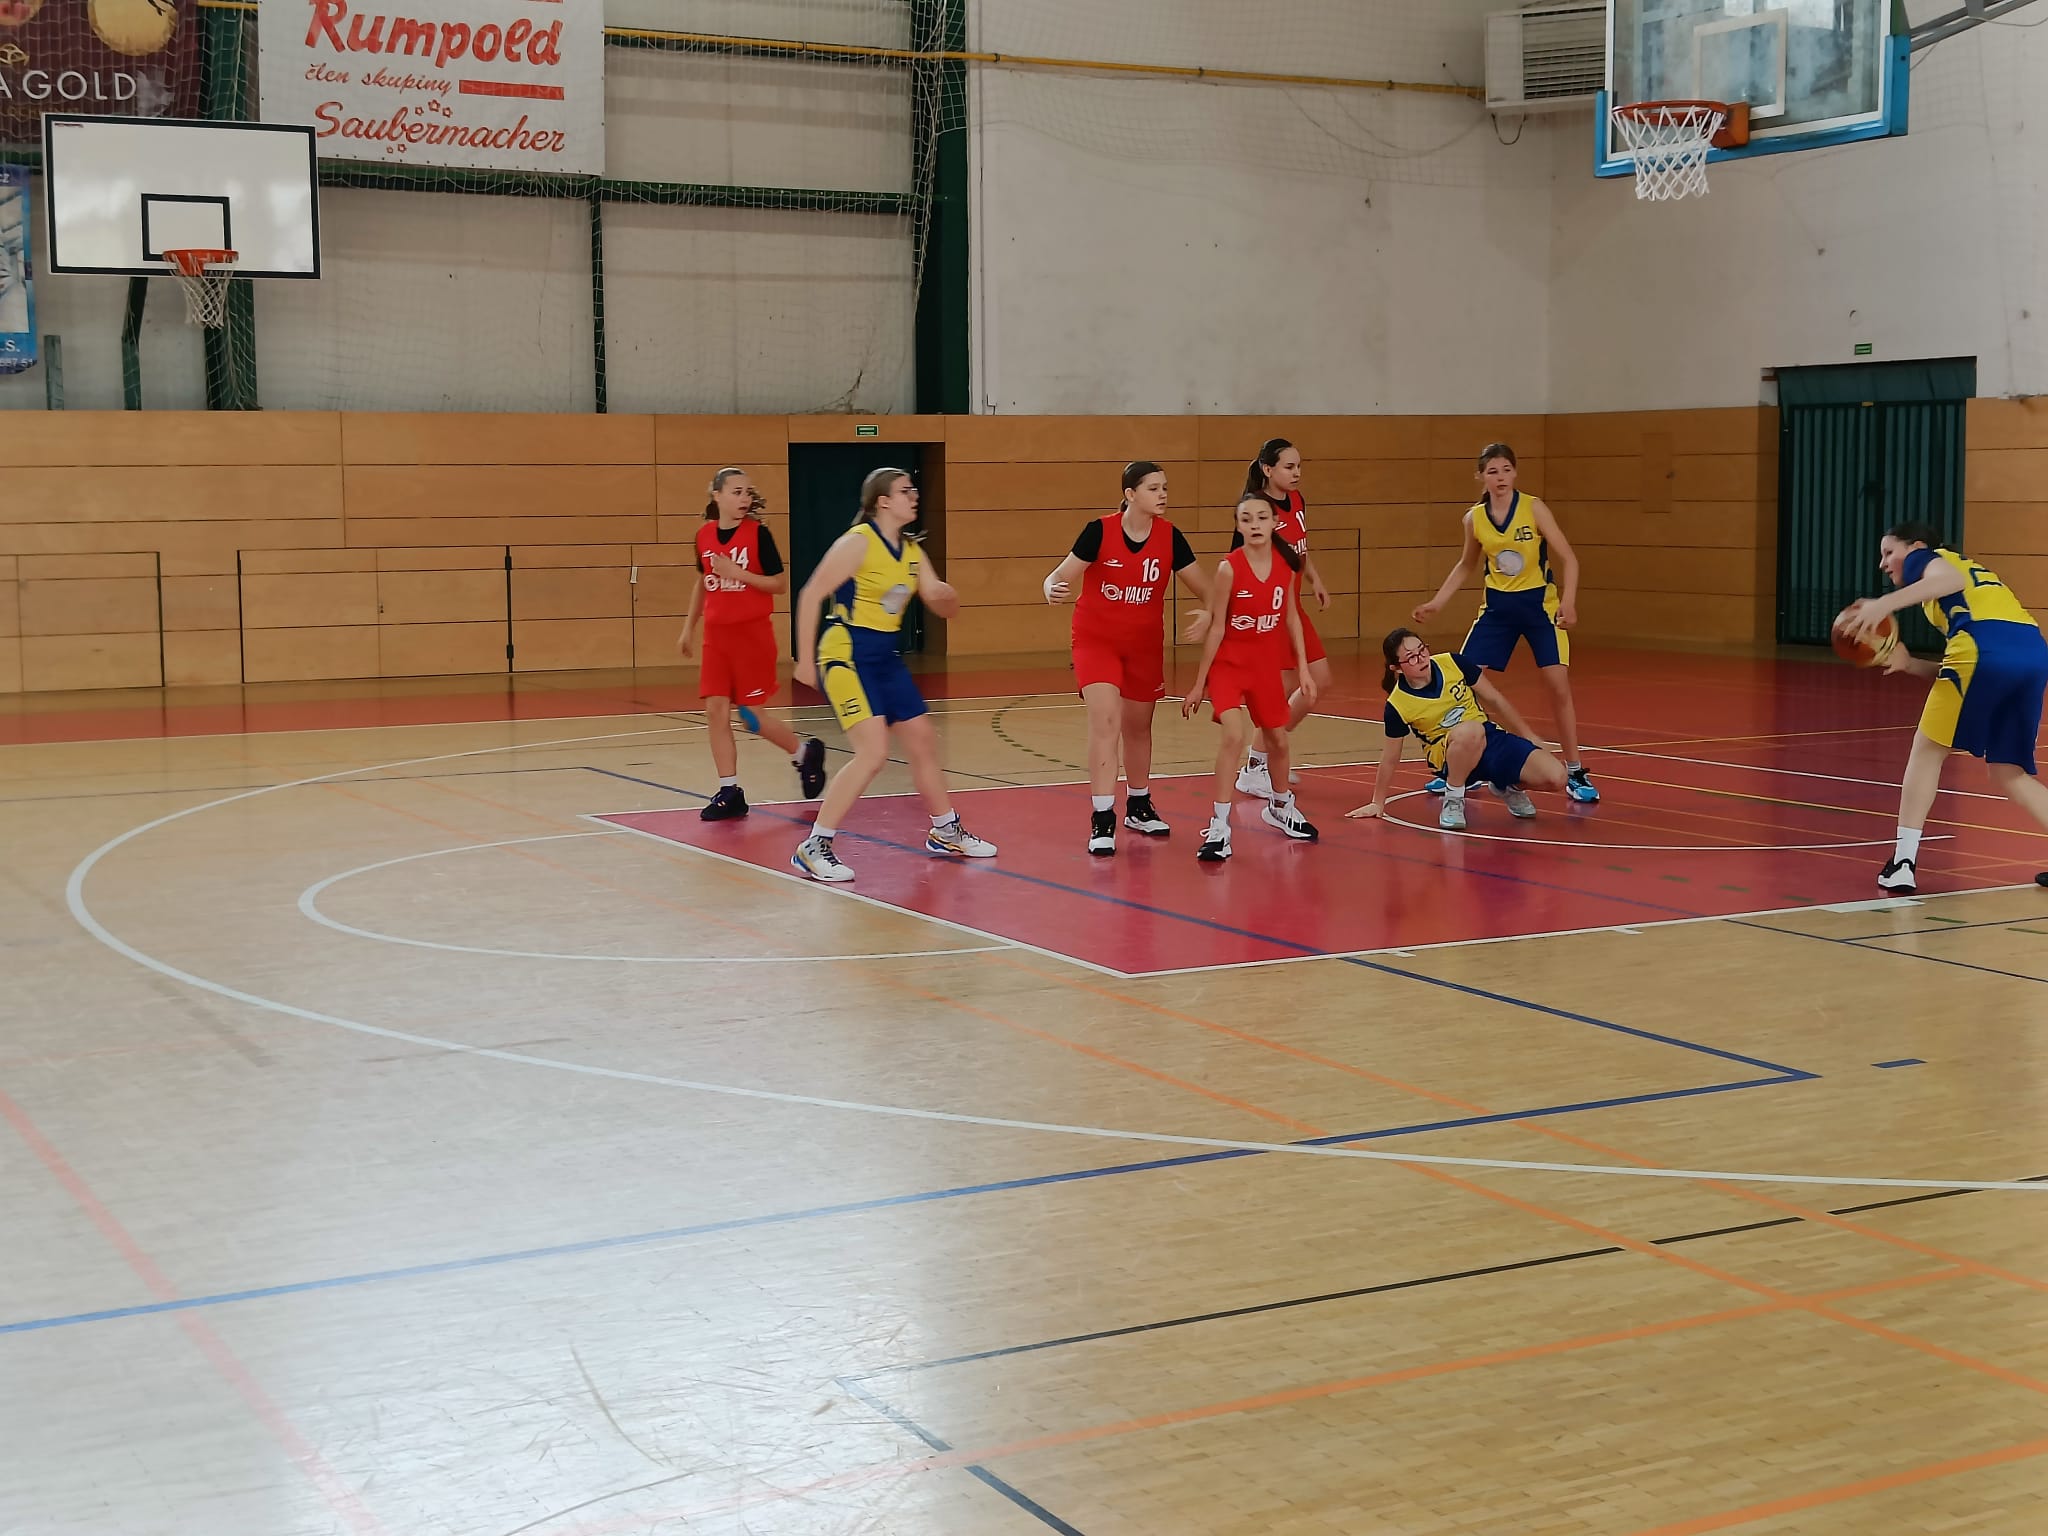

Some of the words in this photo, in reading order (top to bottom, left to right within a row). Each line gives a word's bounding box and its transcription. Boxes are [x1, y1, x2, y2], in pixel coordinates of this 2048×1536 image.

[304, 0, 564, 68] Rumpold
[22, 70, 137, 101] GOLD
[304, 63, 350, 84] člen
[360, 67, 452, 97] skupiny
[314, 101, 565, 152] Saubermacher
[729, 546, 749, 570] 14
[1142, 557, 1160, 583] 16
[1125, 586, 1153, 603] VALVE
[1272, 586, 1284, 610] 8
